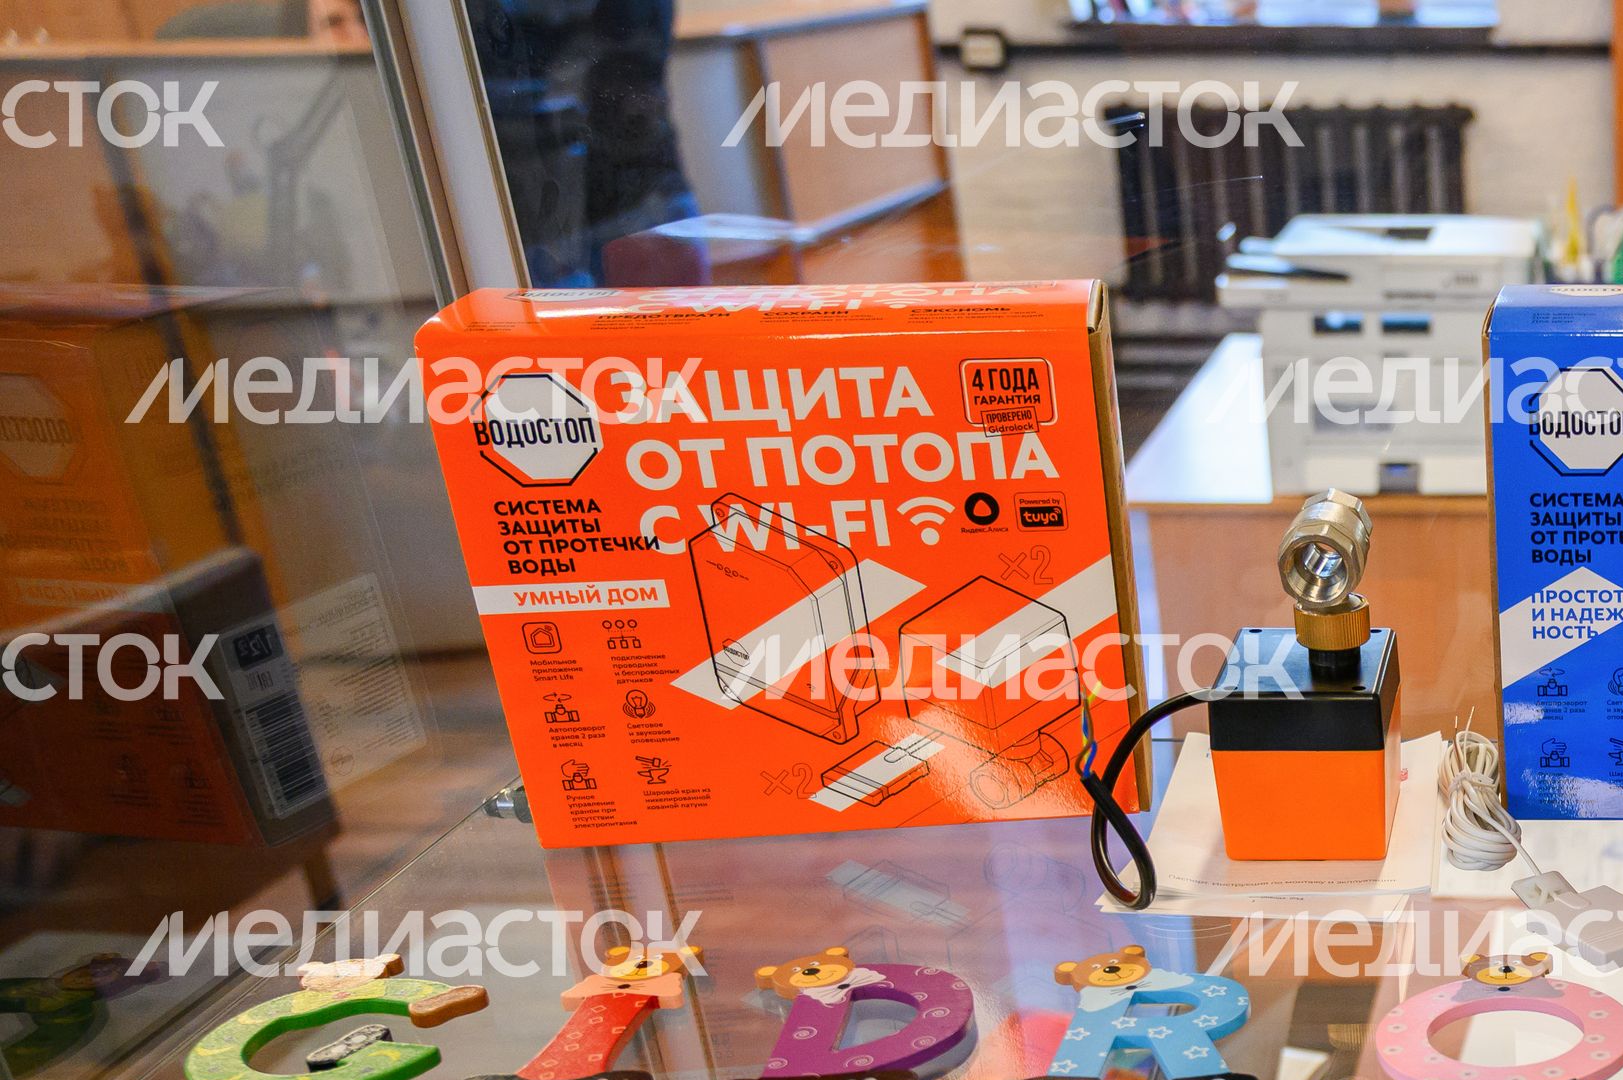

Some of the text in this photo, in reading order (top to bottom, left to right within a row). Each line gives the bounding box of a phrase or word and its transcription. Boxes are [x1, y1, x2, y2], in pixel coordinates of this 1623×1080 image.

[971, 367, 1039, 392] 4 ГОДА
[610, 366, 934, 432] ЗАЩИТА
[974, 394, 1041, 406] ГАРАНТИЯ
[986, 411, 1032, 423] ПРОВЕРЕНО
[472, 418, 596, 449] ВОДОСТОП
[988, 422, 1034, 434] Gidrolock
[626, 432, 1060, 491] ОТ ПОТОПА
[494, 498, 602, 516] СИСТЕМА
[1050, 497, 1060, 506] by
[1023, 509, 1058, 523] tuya
[1530, 512, 1622, 529] ЗАЩИТЫ
[499, 518, 601, 536] ЗАЩИТЫ
[640, 499, 891, 555] С WI-FI
[504, 536, 660, 555] ОТ ПРОТЕЧКИ
[1531, 531, 1557, 545] ОТ
[1532, 549, 1591, 566] ВОДЫ
[508, 559, 576, 576] ВОДЫ
[513, 585, 659, 607] УМНЫЙ ДОМ
[1532, 608, 1544, 621] И
[1532, 626, 1599, 639] НОСТЬ
